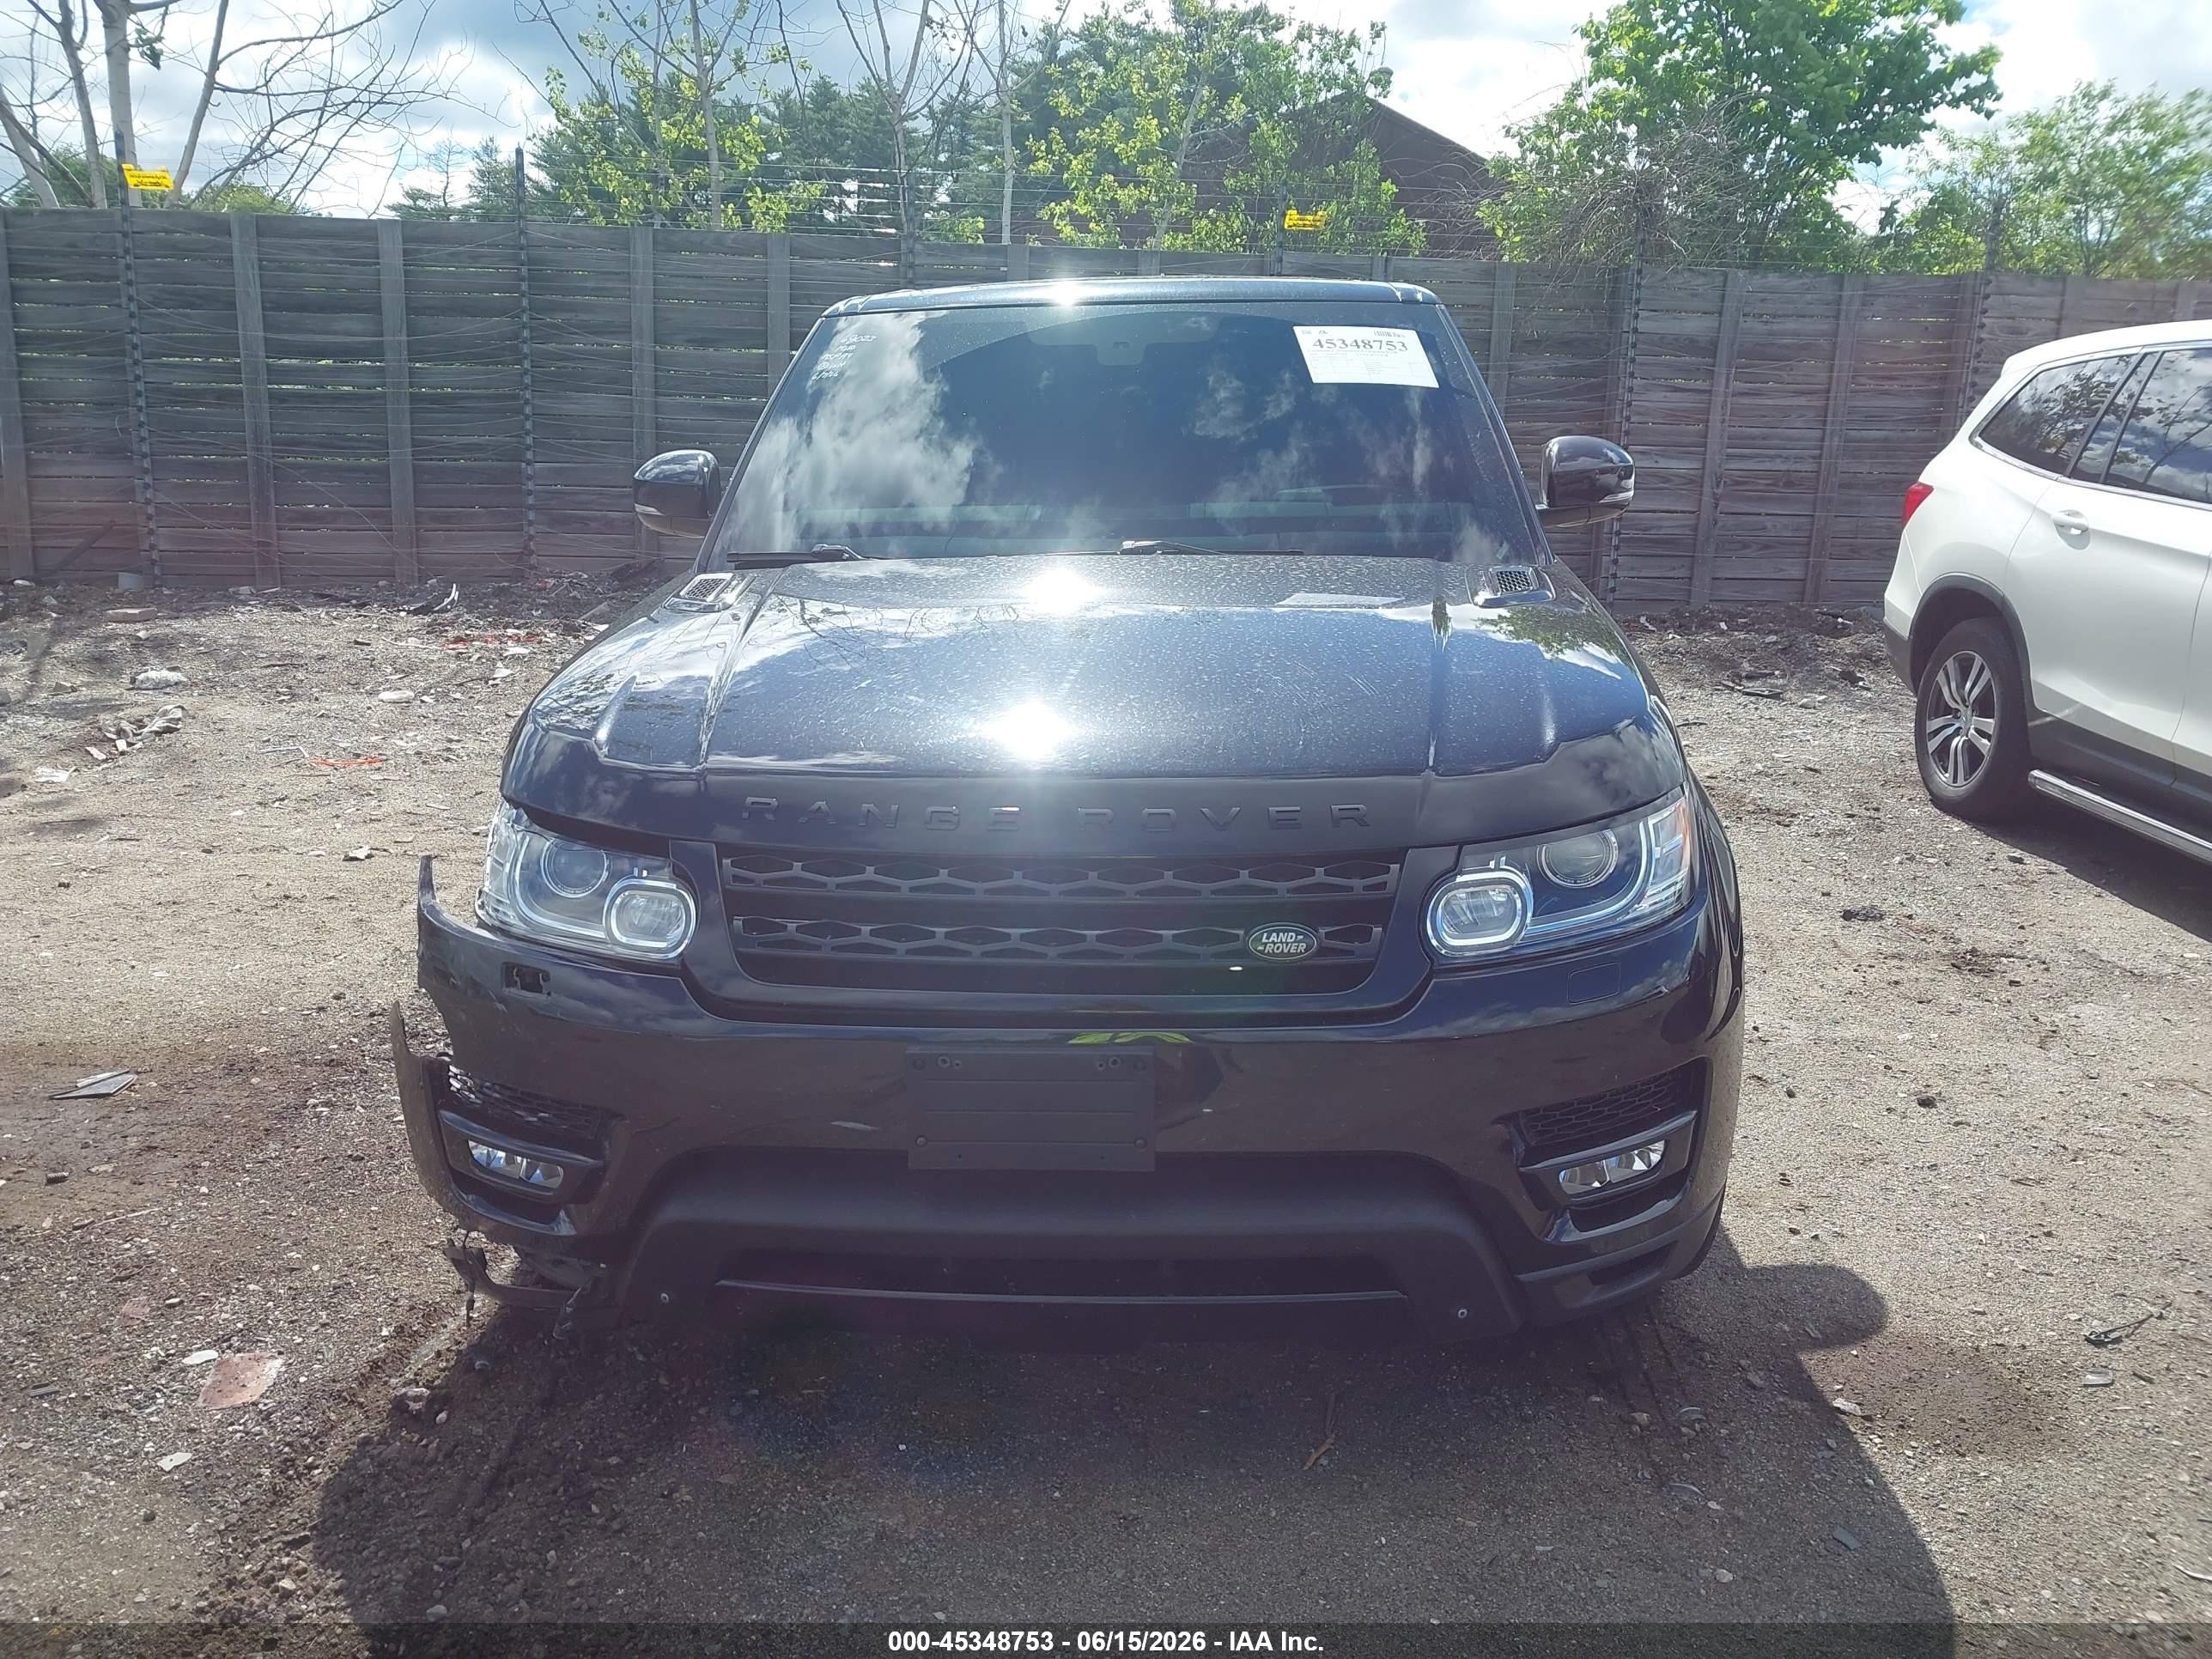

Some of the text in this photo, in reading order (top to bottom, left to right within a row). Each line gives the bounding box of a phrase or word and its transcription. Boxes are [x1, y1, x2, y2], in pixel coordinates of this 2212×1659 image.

[1312, 337, 1408, 352] 45348753
[741, 796, 1370, 831] RANGE ROVER
